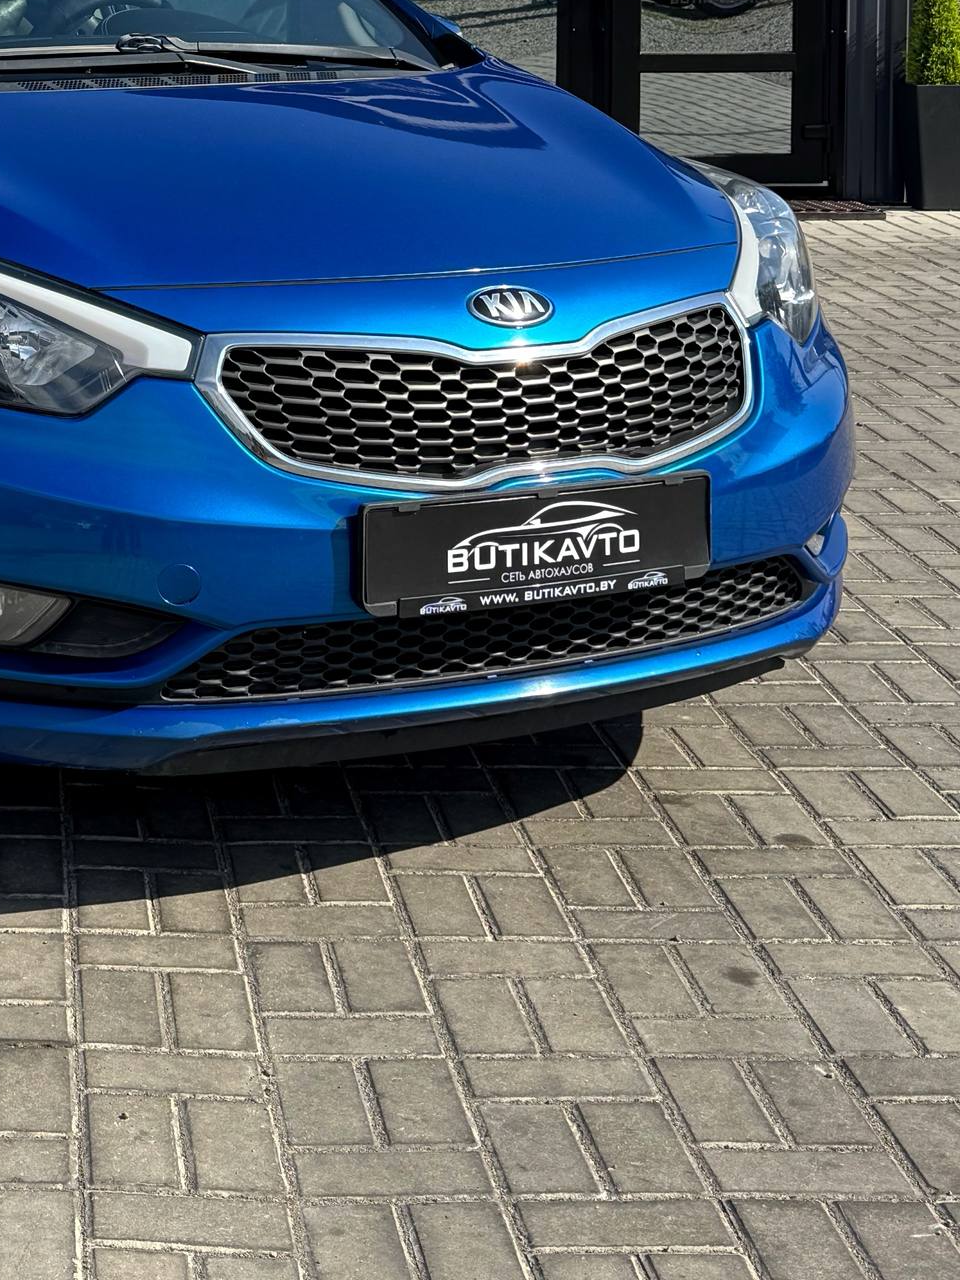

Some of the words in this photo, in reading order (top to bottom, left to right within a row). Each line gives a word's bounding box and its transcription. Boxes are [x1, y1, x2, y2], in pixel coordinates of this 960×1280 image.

[479, 291, 545, 319] KIA
[448, 529, 640, 573] BUTIKAVTO
[501, 572, 526, 583] СЕТЬ
[528, 563, 594, 580] АВТОХАУСОВ
[628, 578, 669, 590] BUTIKAVTO
[480, 592, 519, 606] WWW.
[524, 580, 617, 601] BUTIKAVTO.BY
[420, 603, 468, 615] BUTIKAVTO
